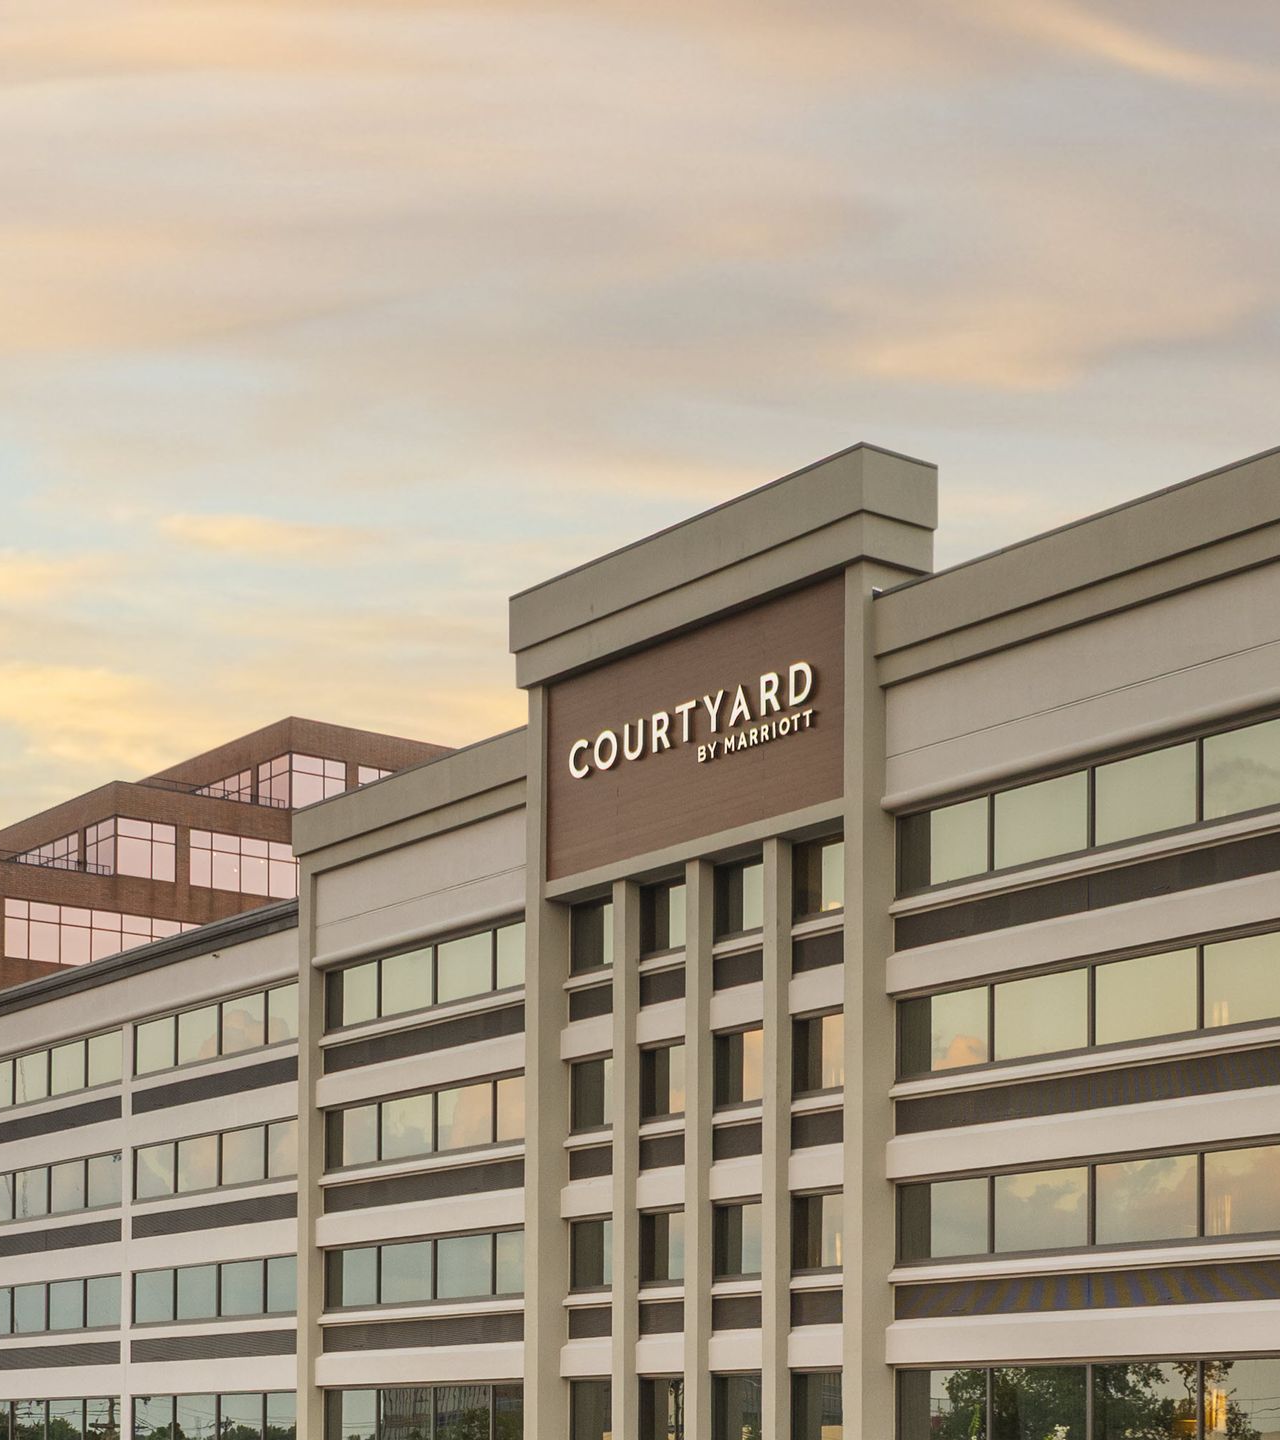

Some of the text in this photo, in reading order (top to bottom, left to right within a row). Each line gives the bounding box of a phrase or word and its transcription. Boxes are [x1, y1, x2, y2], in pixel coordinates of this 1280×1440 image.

[568, 661, 813, 779] COURTYARD
[697, 709, 813, 763] BY MARRIOTT
